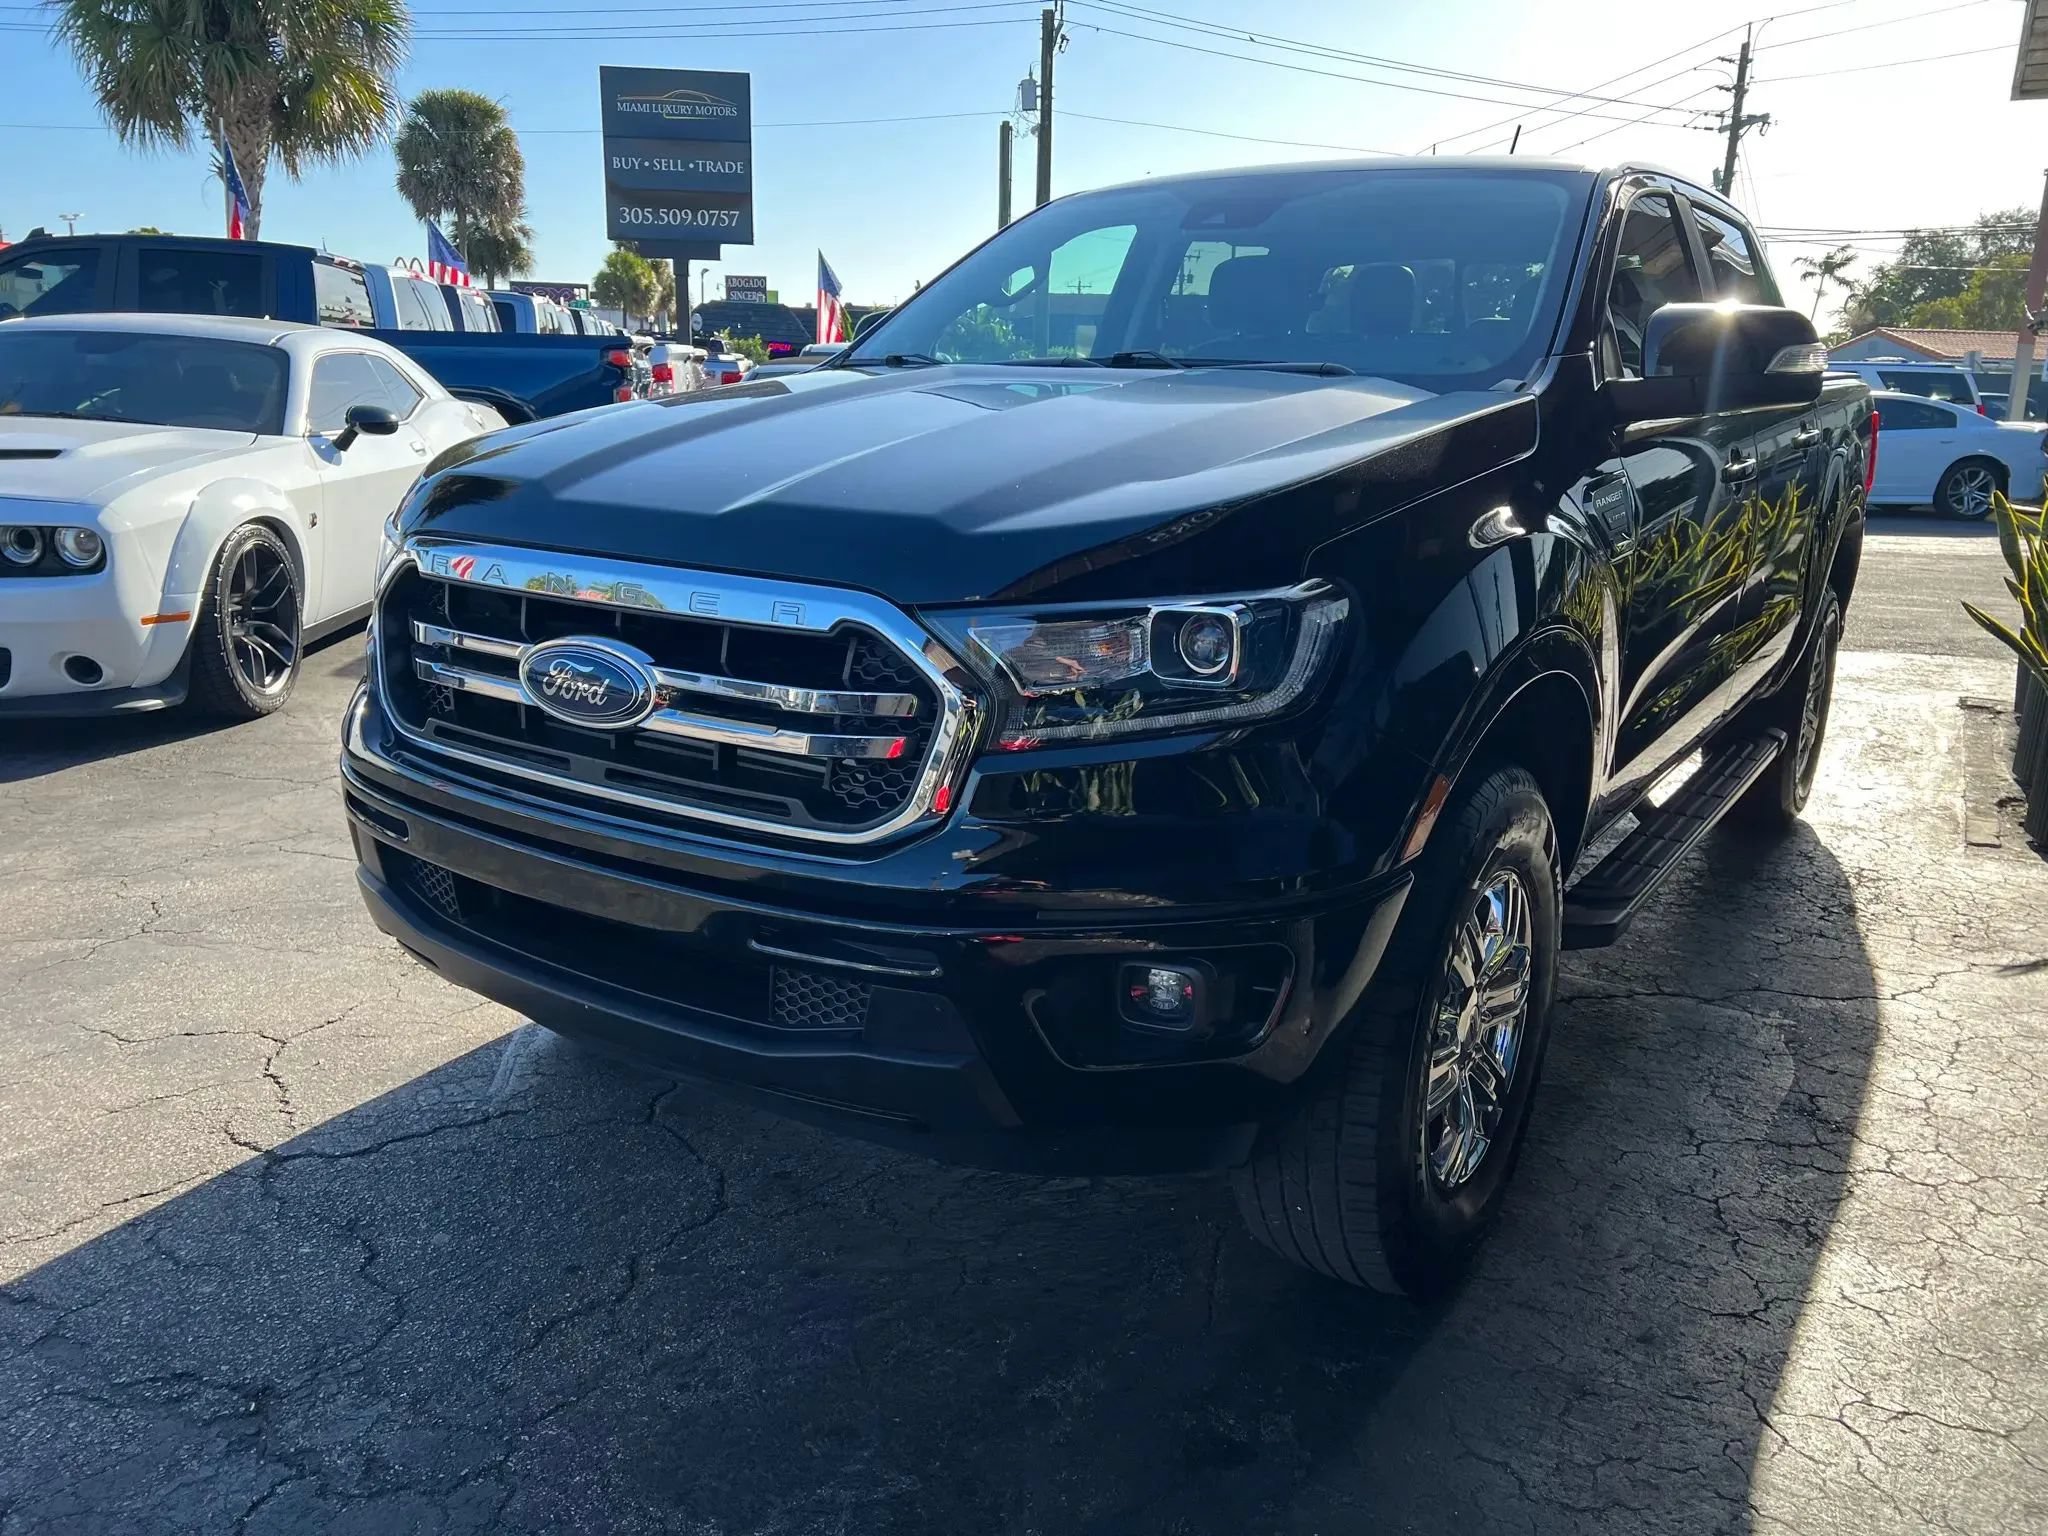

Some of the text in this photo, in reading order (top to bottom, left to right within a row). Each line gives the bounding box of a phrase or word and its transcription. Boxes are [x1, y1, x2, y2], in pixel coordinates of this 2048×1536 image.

[617, 102, 738, 117] MIAMI LUXURY MOTORS
[612, 156, 744, 174] BUY SELL TRADE
[619, 207, 740, 227] 305.509.0757
[727, 278, 765, 288] ABOGADO
[1596, 490, 1623, 508] RANGER
[430, 553, 806, 626] RANGER
[542, 658, 610, 706] Ford
